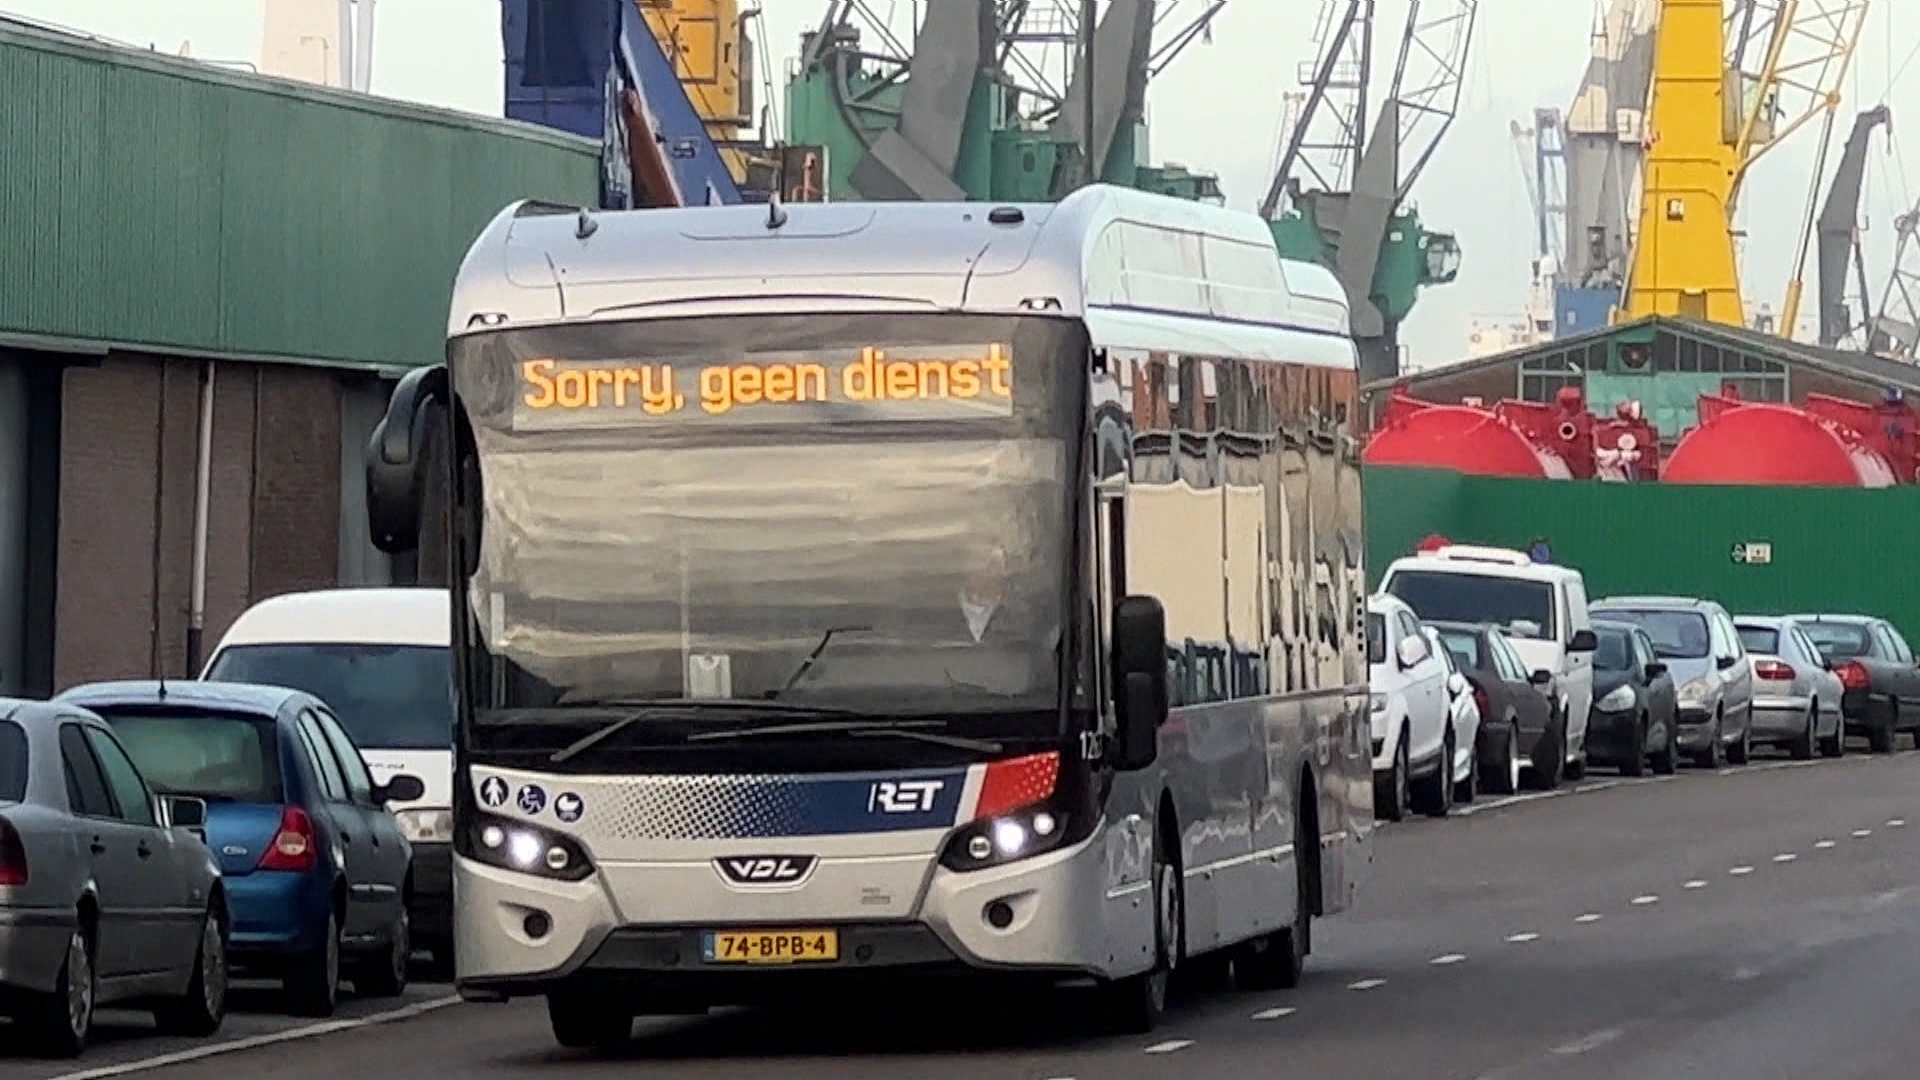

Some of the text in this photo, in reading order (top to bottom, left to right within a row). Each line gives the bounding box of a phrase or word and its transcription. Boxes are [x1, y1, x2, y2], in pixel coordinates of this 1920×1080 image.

[523, 343, 1010, 414] Sorry, geen dienst
[868, 781, 944, 812] RET
[729, 859, 799, 878] VDL
[722, 934, 827, 957] 74-BPB-4
